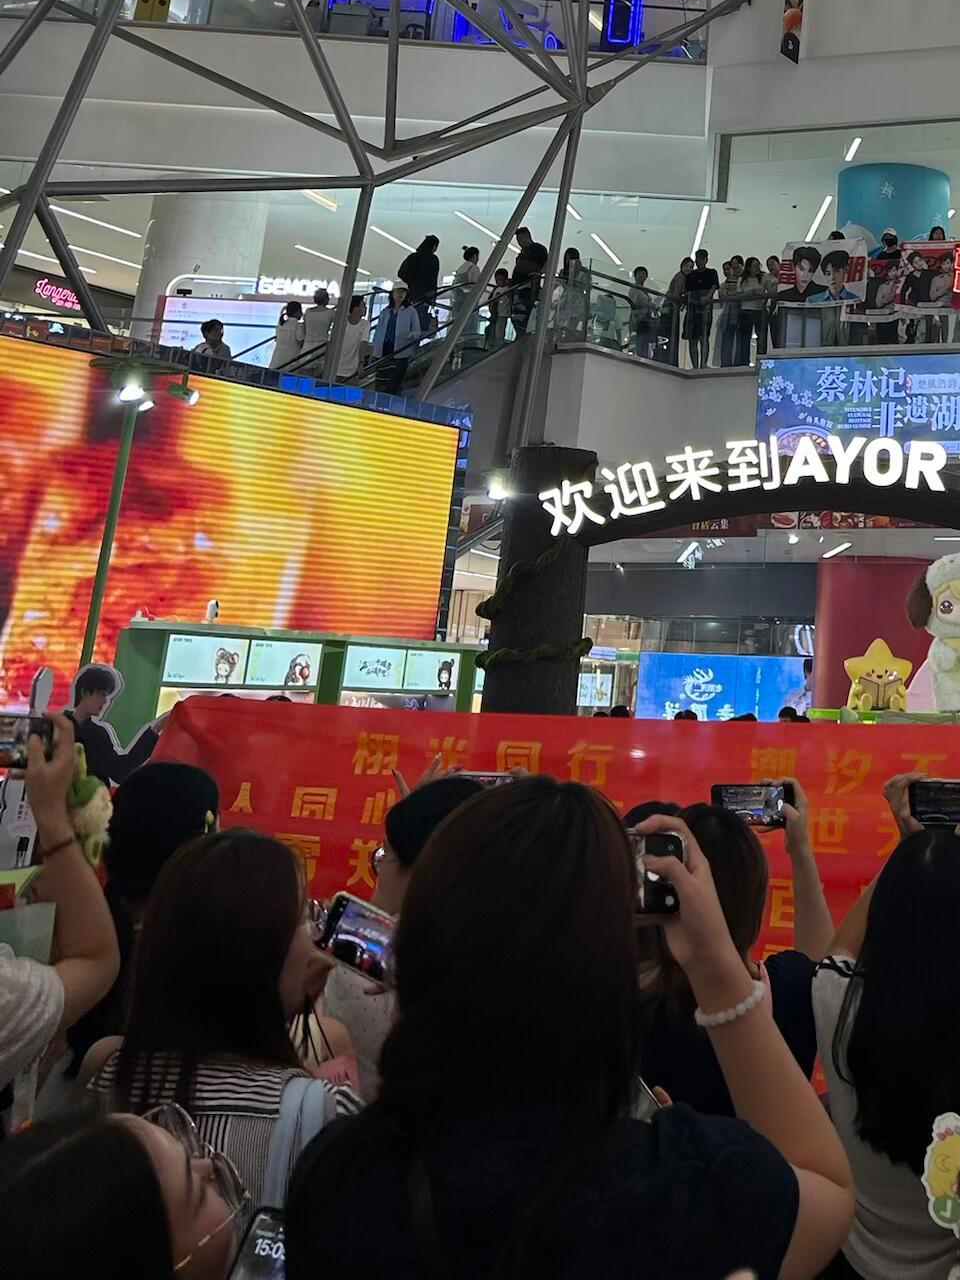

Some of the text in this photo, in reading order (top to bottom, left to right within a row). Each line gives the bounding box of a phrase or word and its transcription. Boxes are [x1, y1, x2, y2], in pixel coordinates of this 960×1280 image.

[816, 366, 905, 402] 蔡林记
[785, 437, 947, 493] AYOR
[254, 1237, 285, 1261] 15:0
